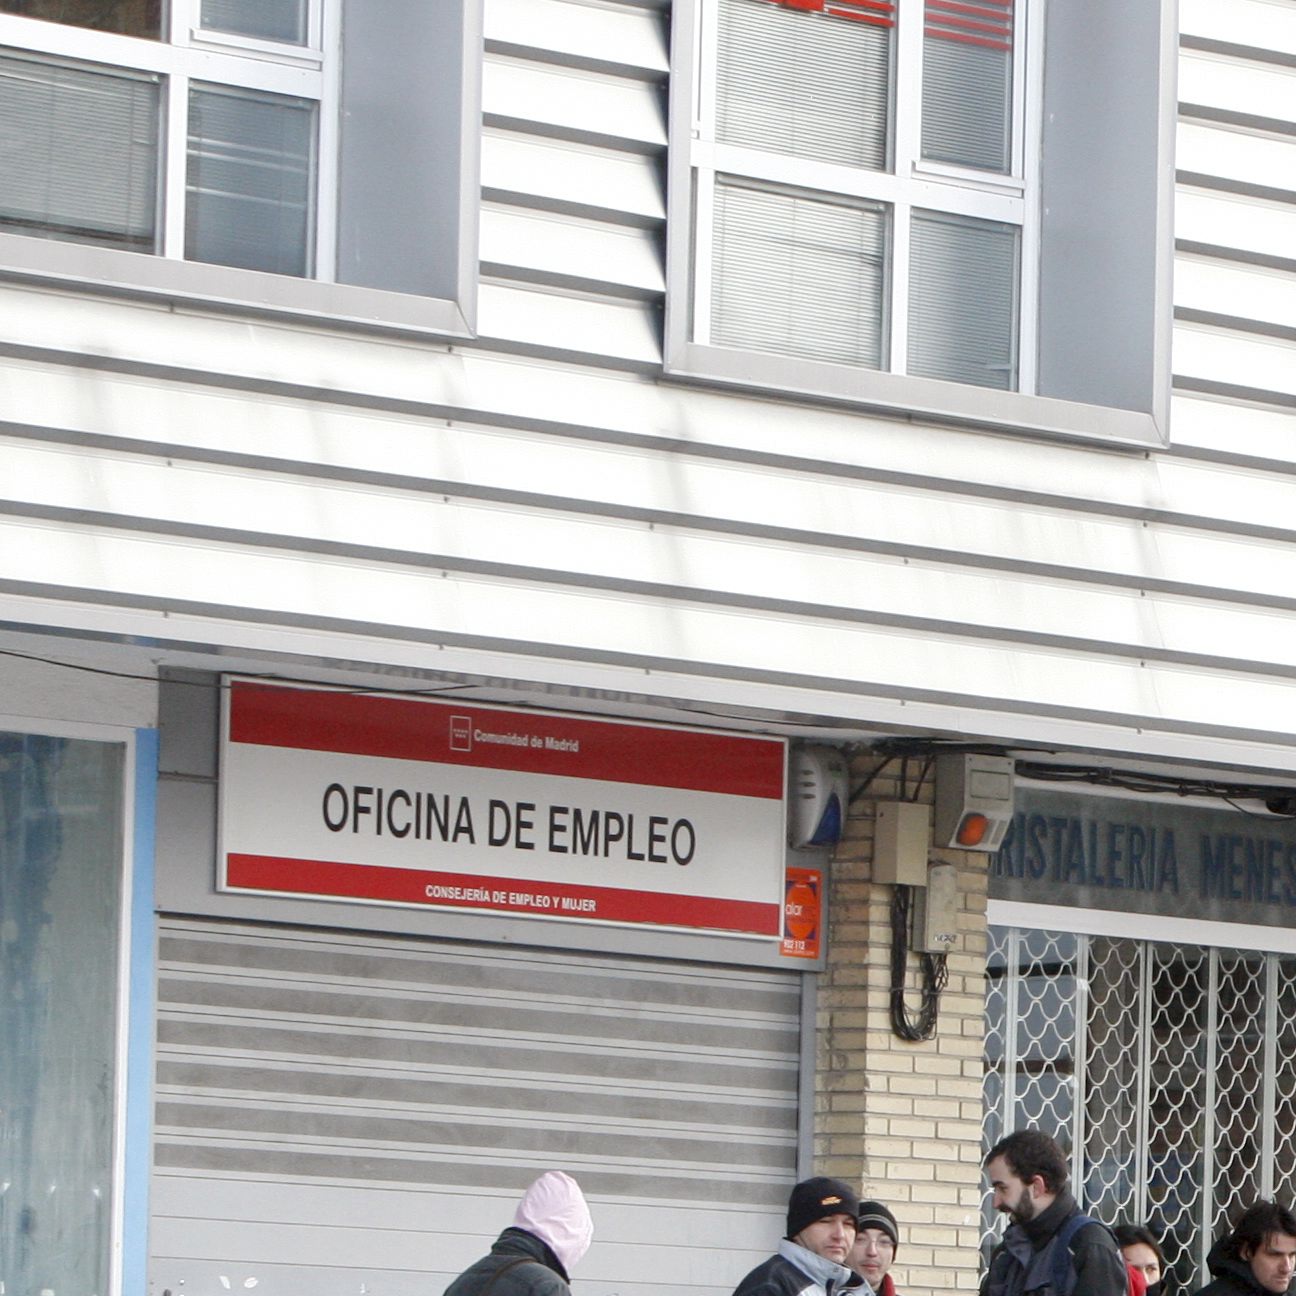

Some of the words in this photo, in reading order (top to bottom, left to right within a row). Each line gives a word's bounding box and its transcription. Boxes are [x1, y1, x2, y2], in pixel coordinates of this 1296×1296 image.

[474, 729, 528, 748] Comunidad
[530, 735, 543, 748] de
[545, 737, 579, 752] Madrid
[322, 783, 476, 844] OFICINA
[488, 799, 536, 850] DE
[548, 806, 696, 866] EMPLEO
[989, 811, 1180, 896] RISTALERIA
[425, 884, 490, 902] CONSEJERÍA
[492, 891, 506, 904] DE
[508, 892, 550, 908] EMPLEO
[553, 897, 559, 908] Y
[562, 897, 596, 912] MUJER
